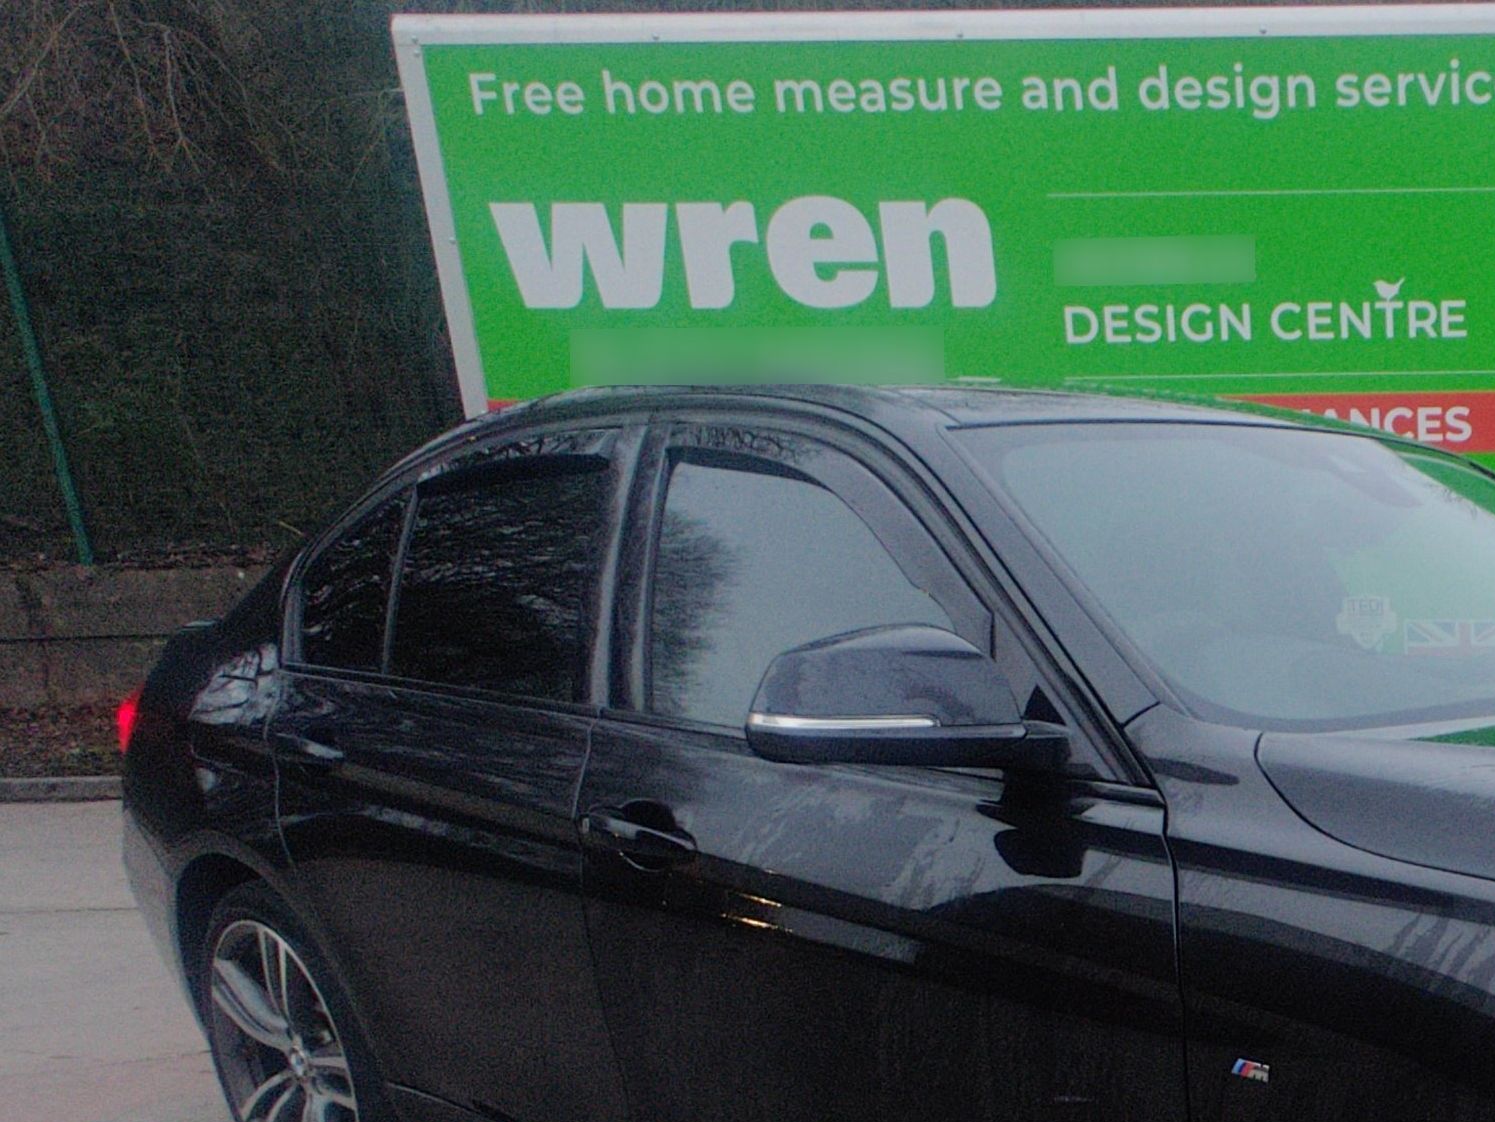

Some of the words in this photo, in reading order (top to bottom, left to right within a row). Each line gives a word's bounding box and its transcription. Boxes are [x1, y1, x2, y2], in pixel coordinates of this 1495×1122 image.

[468, 73, 585, 115] Free
[602, 69, 756, 114] home
[774, 77, 1004, 114] measure
[1022, 66, 1120, 112] and
[1138, 63, 1317, 120] design
[489, 196, 998, 309] wren
[1064, 303, 1252, 345] DESIGN
[1270, 299, 1468, 341] CENTRE
